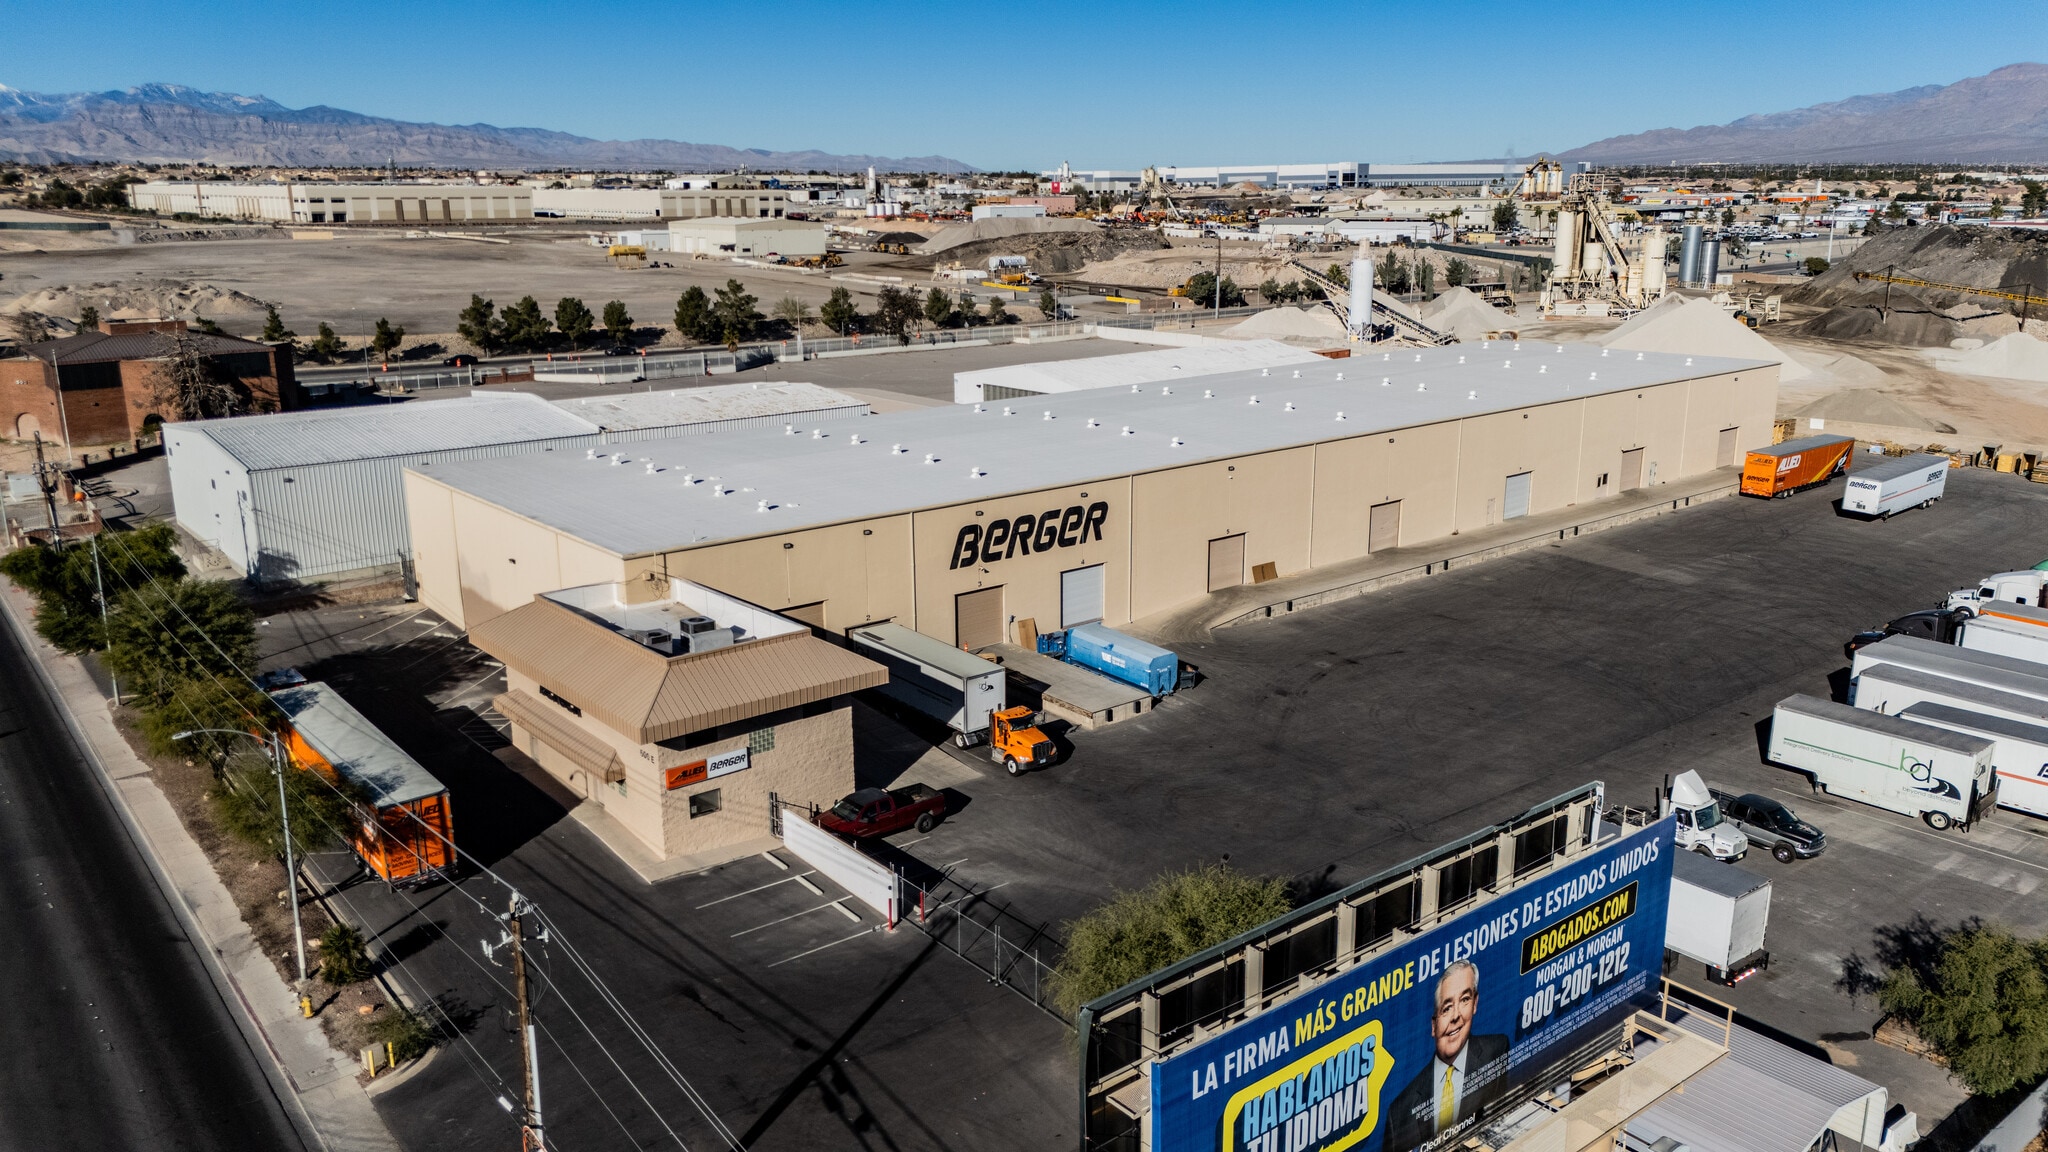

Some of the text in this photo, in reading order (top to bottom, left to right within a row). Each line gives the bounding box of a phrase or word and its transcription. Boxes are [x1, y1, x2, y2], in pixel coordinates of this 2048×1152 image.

[1849, 481, 1877, 490] BERGER
[950, 501, 1108, 570] BERGER
[679, 766, 705, 778] ALLIED
[710, 754, 746, 771] BERGER
[1902, 786, 1960, 806] beyond distribution
[1530, 891, 1629, 964] ABOGADOS.COM
[1536, 928, 1623, 988] MORGAN & MORGAN
[1192, 837, 1660, 1100] LA FIRMA MÁS GRANDE DE LESIONES DE ESTADOS UNIDOS
[1522, 942, 1630, 1029] 800-200-1212
[1244, 1034, 1376, 1144] HABLAMOS
[1285, 1077, 1368, 1152] IDIOMA
[1420, 1135, 1442, 1152] Clear
[1443, 1112, 1476, 1140] Channel
